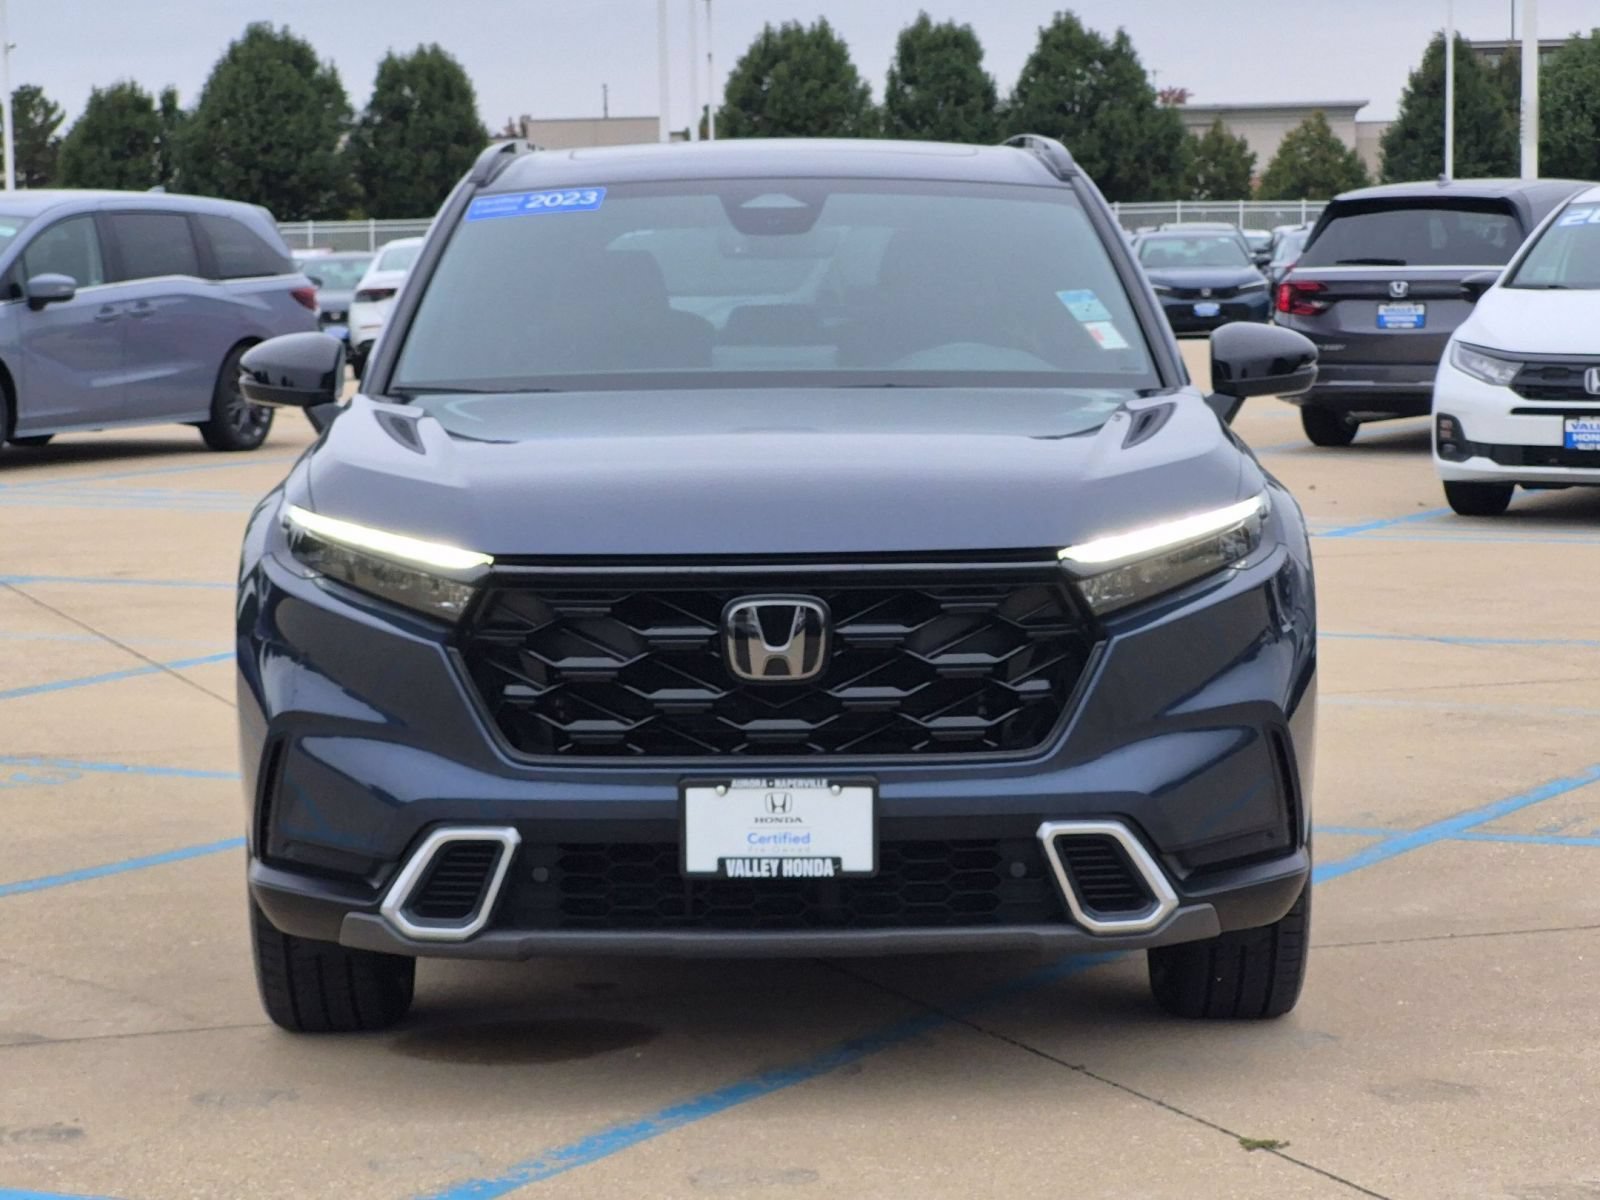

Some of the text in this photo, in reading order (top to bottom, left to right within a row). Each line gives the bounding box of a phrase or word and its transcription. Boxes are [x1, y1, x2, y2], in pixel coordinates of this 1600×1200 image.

[525, 191, 598, 209] 2023
[754, 816, 803, 824] HONDA
[747, 831, 811, 845] Certified
[725, 858, 834, 877] VALLEY HONDA
